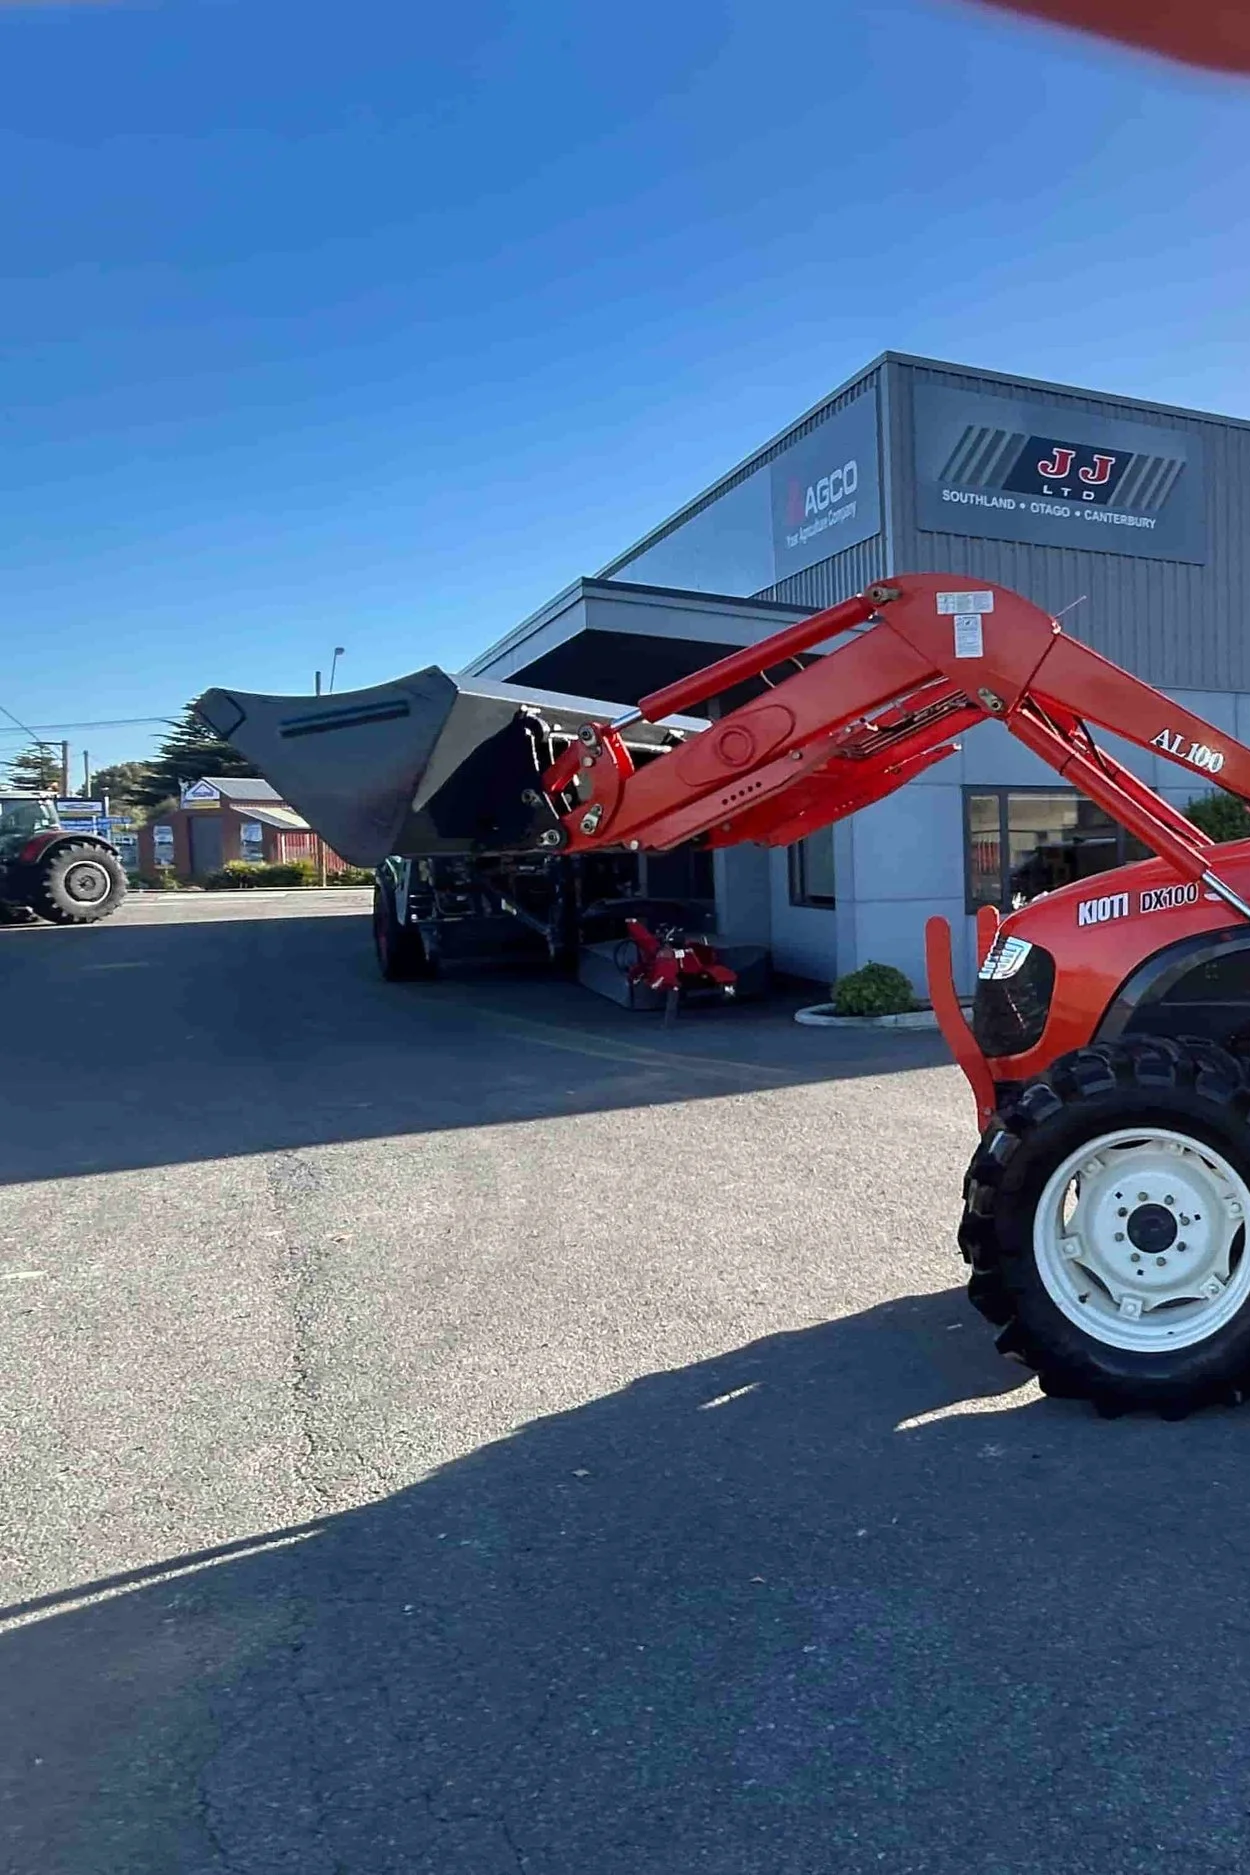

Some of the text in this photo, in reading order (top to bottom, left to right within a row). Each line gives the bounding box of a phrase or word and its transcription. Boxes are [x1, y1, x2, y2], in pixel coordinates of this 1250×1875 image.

[1037, 447, 1116, 485] JJ
[805, 460, 858, 517] AGCO
[942, 489, 1156, 529] SOUTHLAND OTAGO CANTERBURY
[1043, 484, 1095, 501] LTD
[1149, 728, 1224, 774] AL100
[1078, 883, 1198, 927] KIOTI DX100
